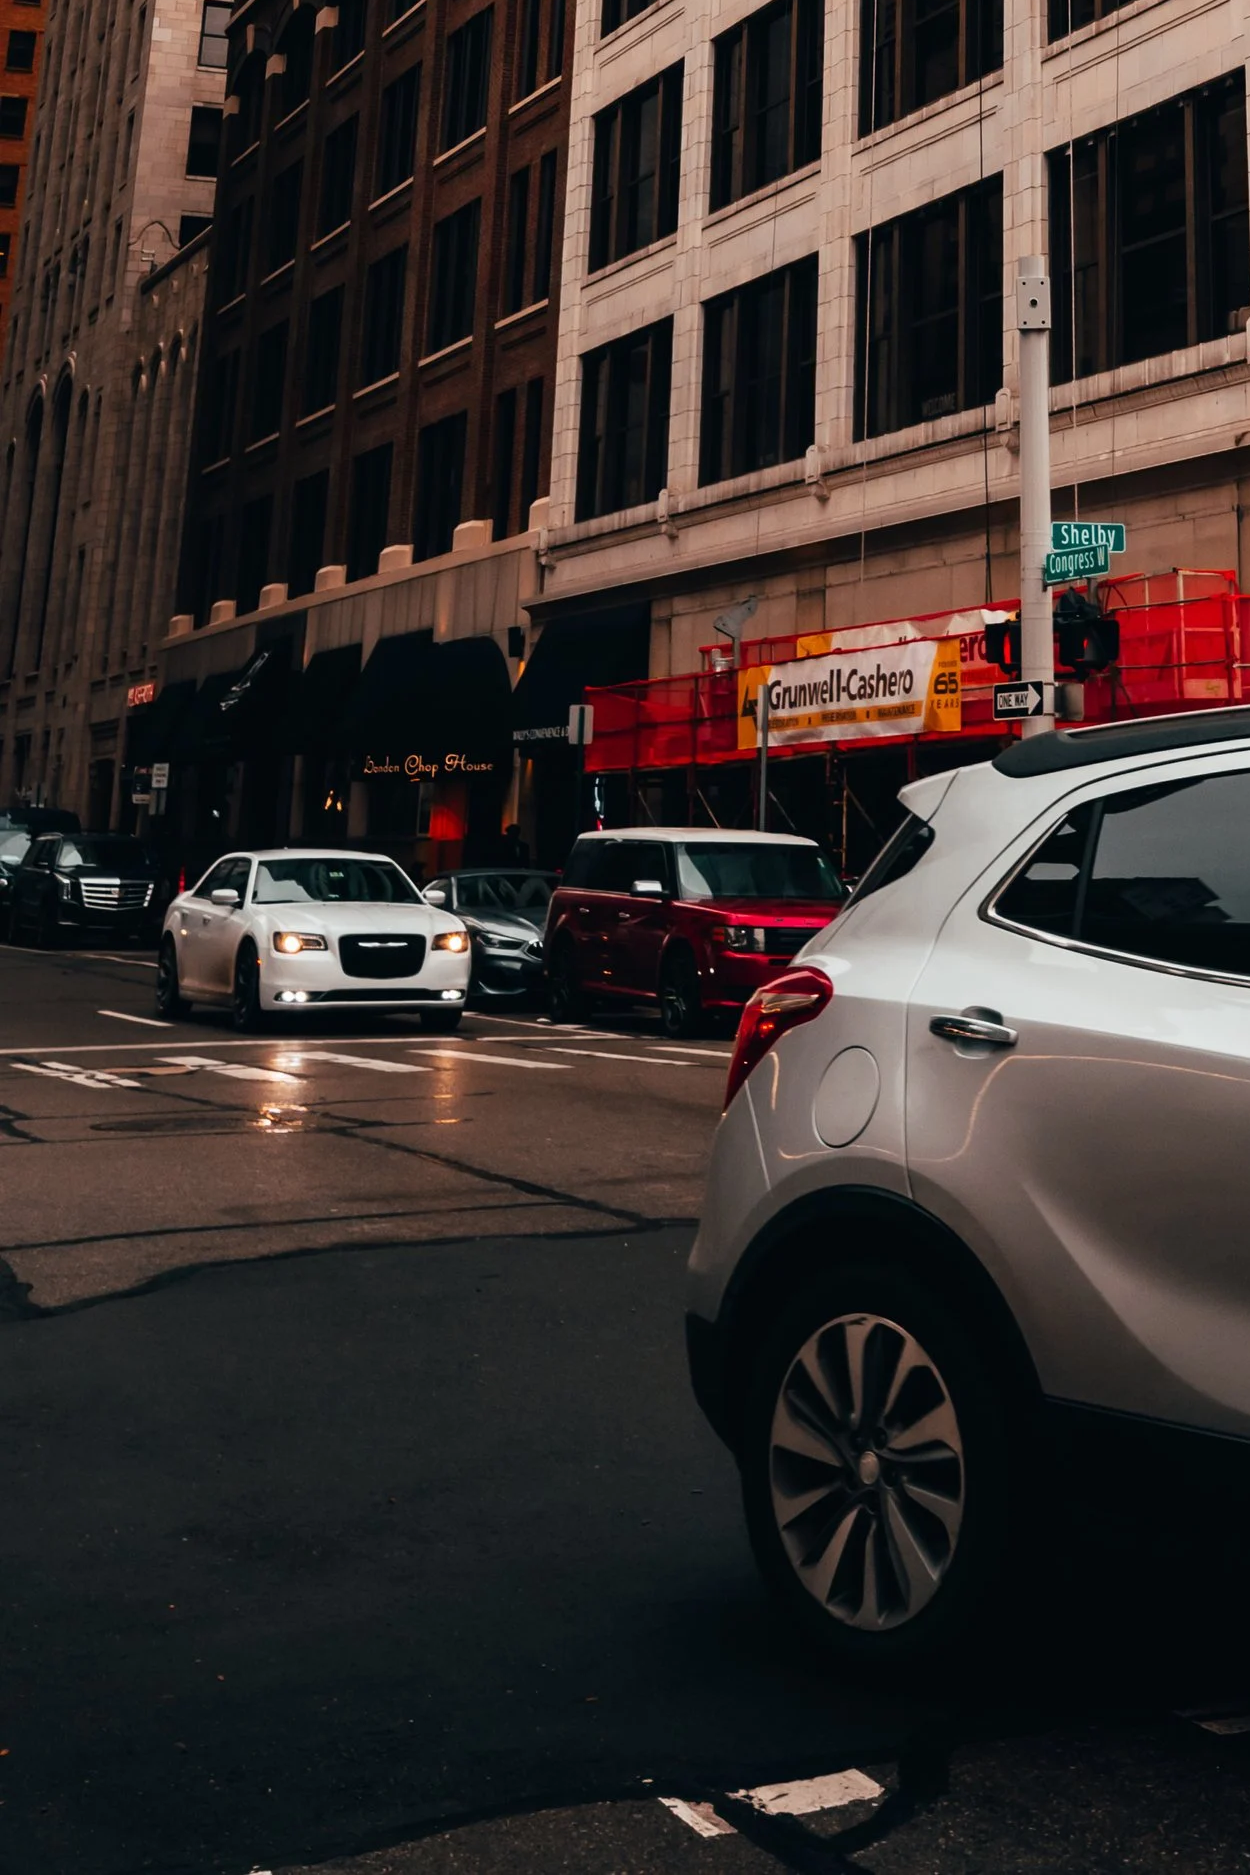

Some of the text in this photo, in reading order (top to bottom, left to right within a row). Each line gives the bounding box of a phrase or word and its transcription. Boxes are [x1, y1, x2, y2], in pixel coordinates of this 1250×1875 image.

[1061, 524, 1116, 551] Shelby
[1049, 546, 1106, 577] Congress W
[768, 663, 915, 711] Grunwell-Cashero
[933, 671, 960, 695] 65
[998, 693, 1028, 708] ONE WAY
[404, 753, 440, 779] Chop
[444, 752, 494, 772] House
